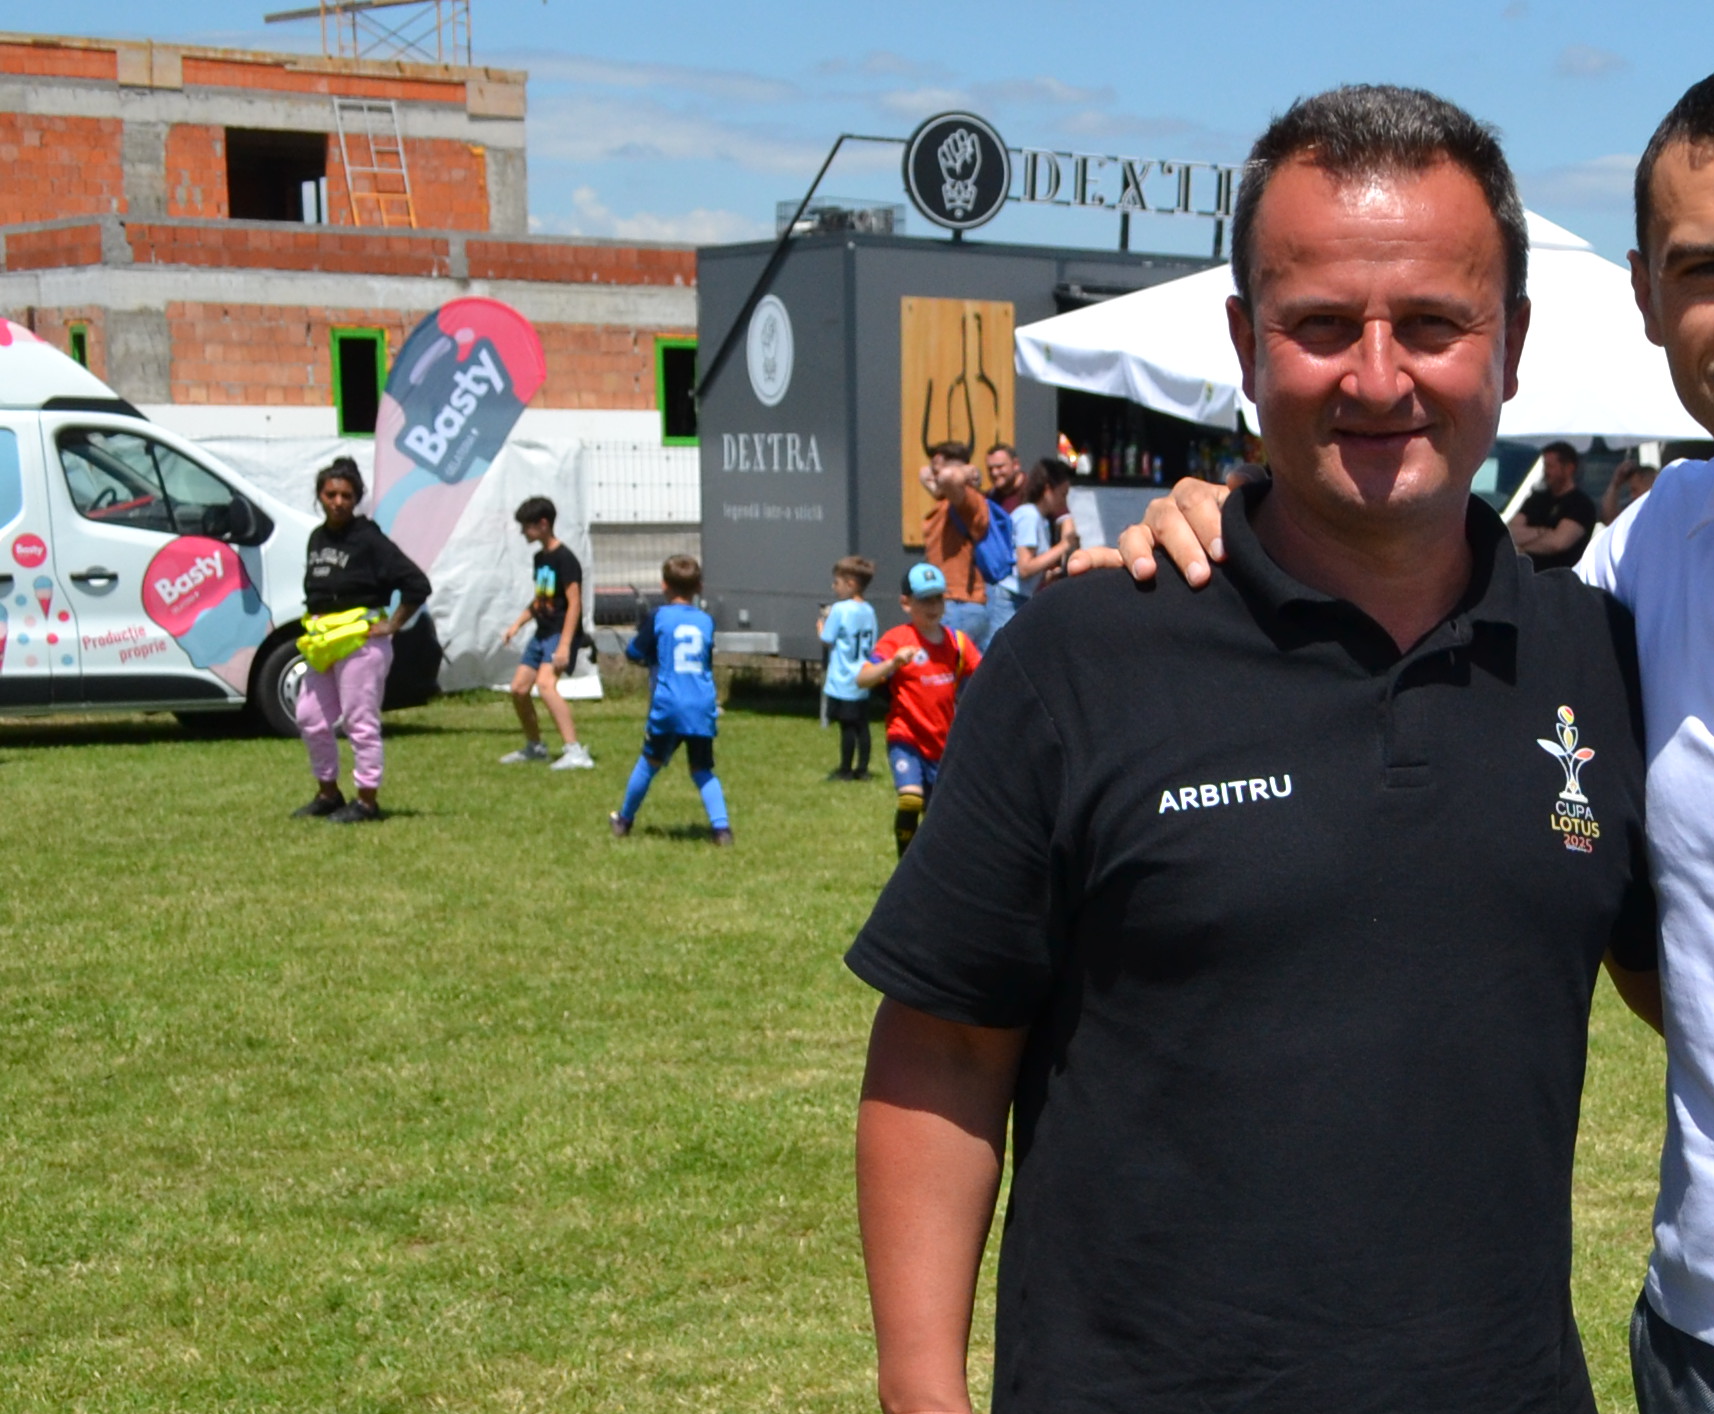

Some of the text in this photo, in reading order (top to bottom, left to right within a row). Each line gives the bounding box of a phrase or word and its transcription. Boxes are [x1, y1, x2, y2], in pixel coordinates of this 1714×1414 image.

[404, 348, 504, 466] Basty
[722, 432, 822, 472] DEXTRA
[153, 550, 224, 605] Basty
[119, 639, 167, 665] proprie
[673, 624, 703, 673] 2
[1158, 774, 1292, 814] ARBITRU
[1555, 800, 1595, 821] CUPA
[1550, 813, 1601, 838] LOTUS
[1563, 833, 1593, 853] 2025
